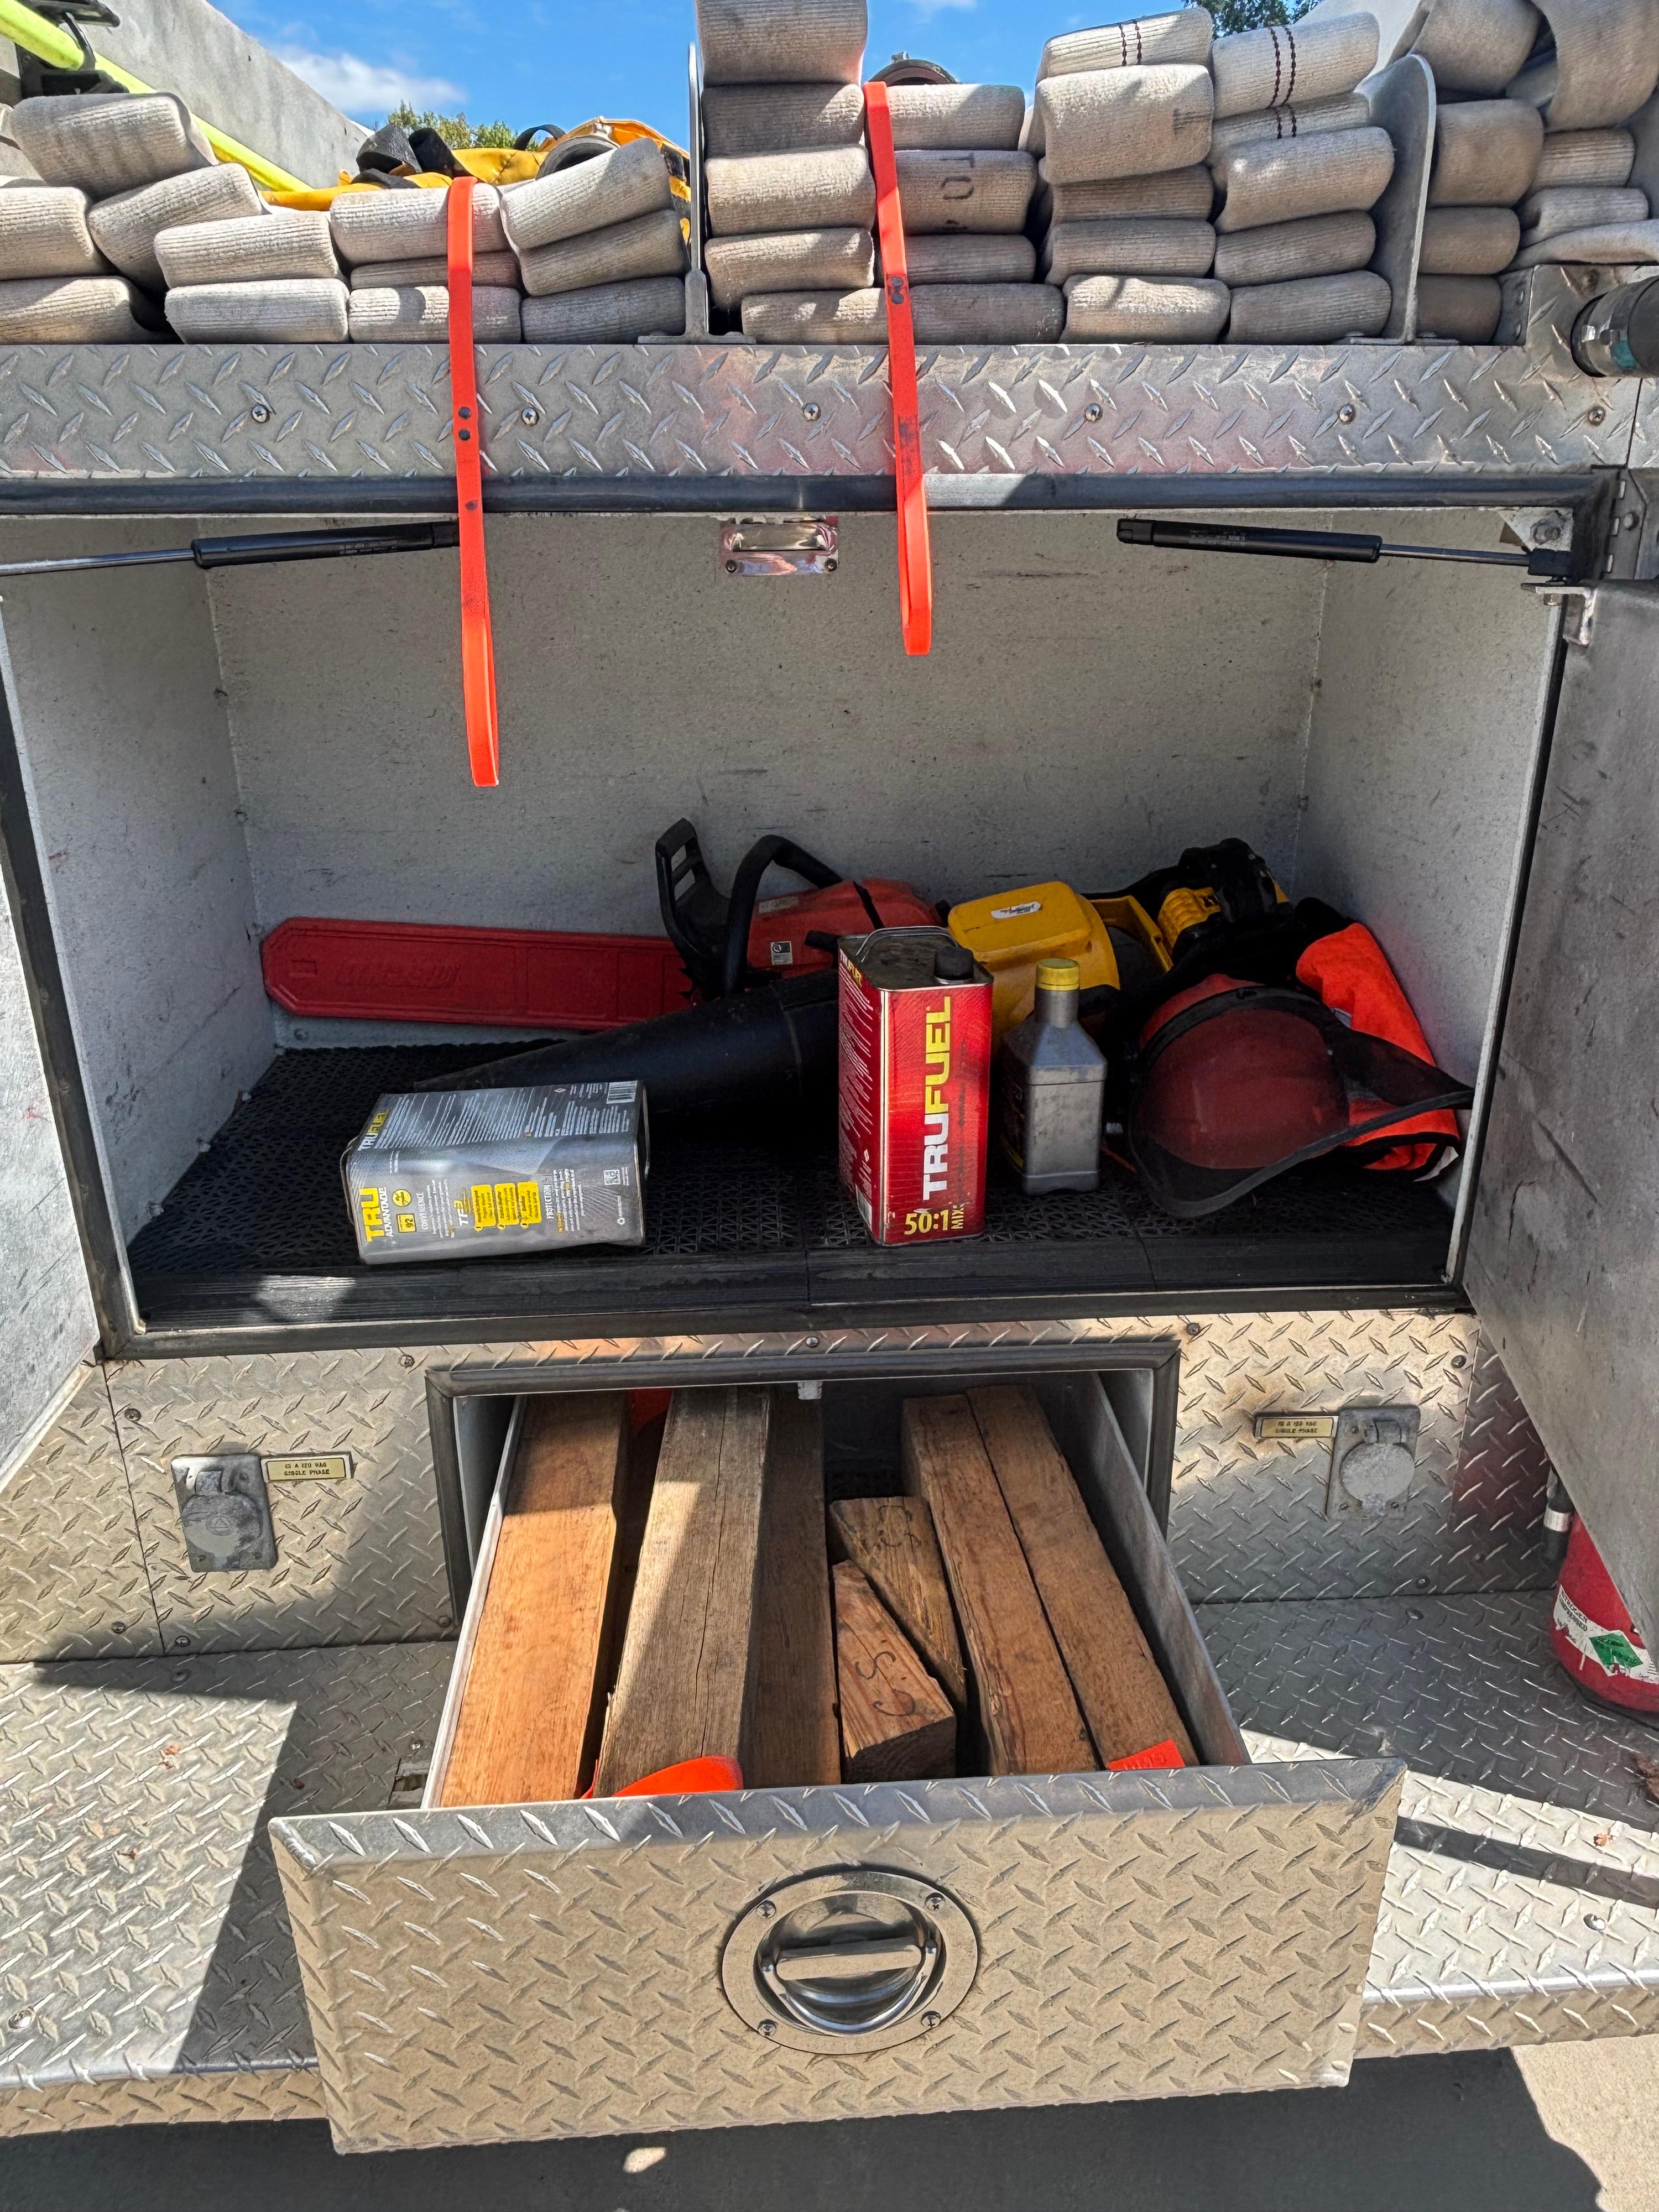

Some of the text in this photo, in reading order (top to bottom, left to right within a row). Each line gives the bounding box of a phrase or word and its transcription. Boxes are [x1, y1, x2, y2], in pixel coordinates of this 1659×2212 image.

[922, 996, 951, 1201] TRUFUEL
[358, 1187, 385, 1243] TRU
[904, 1207, 964, 1235] 50:1 MIX
